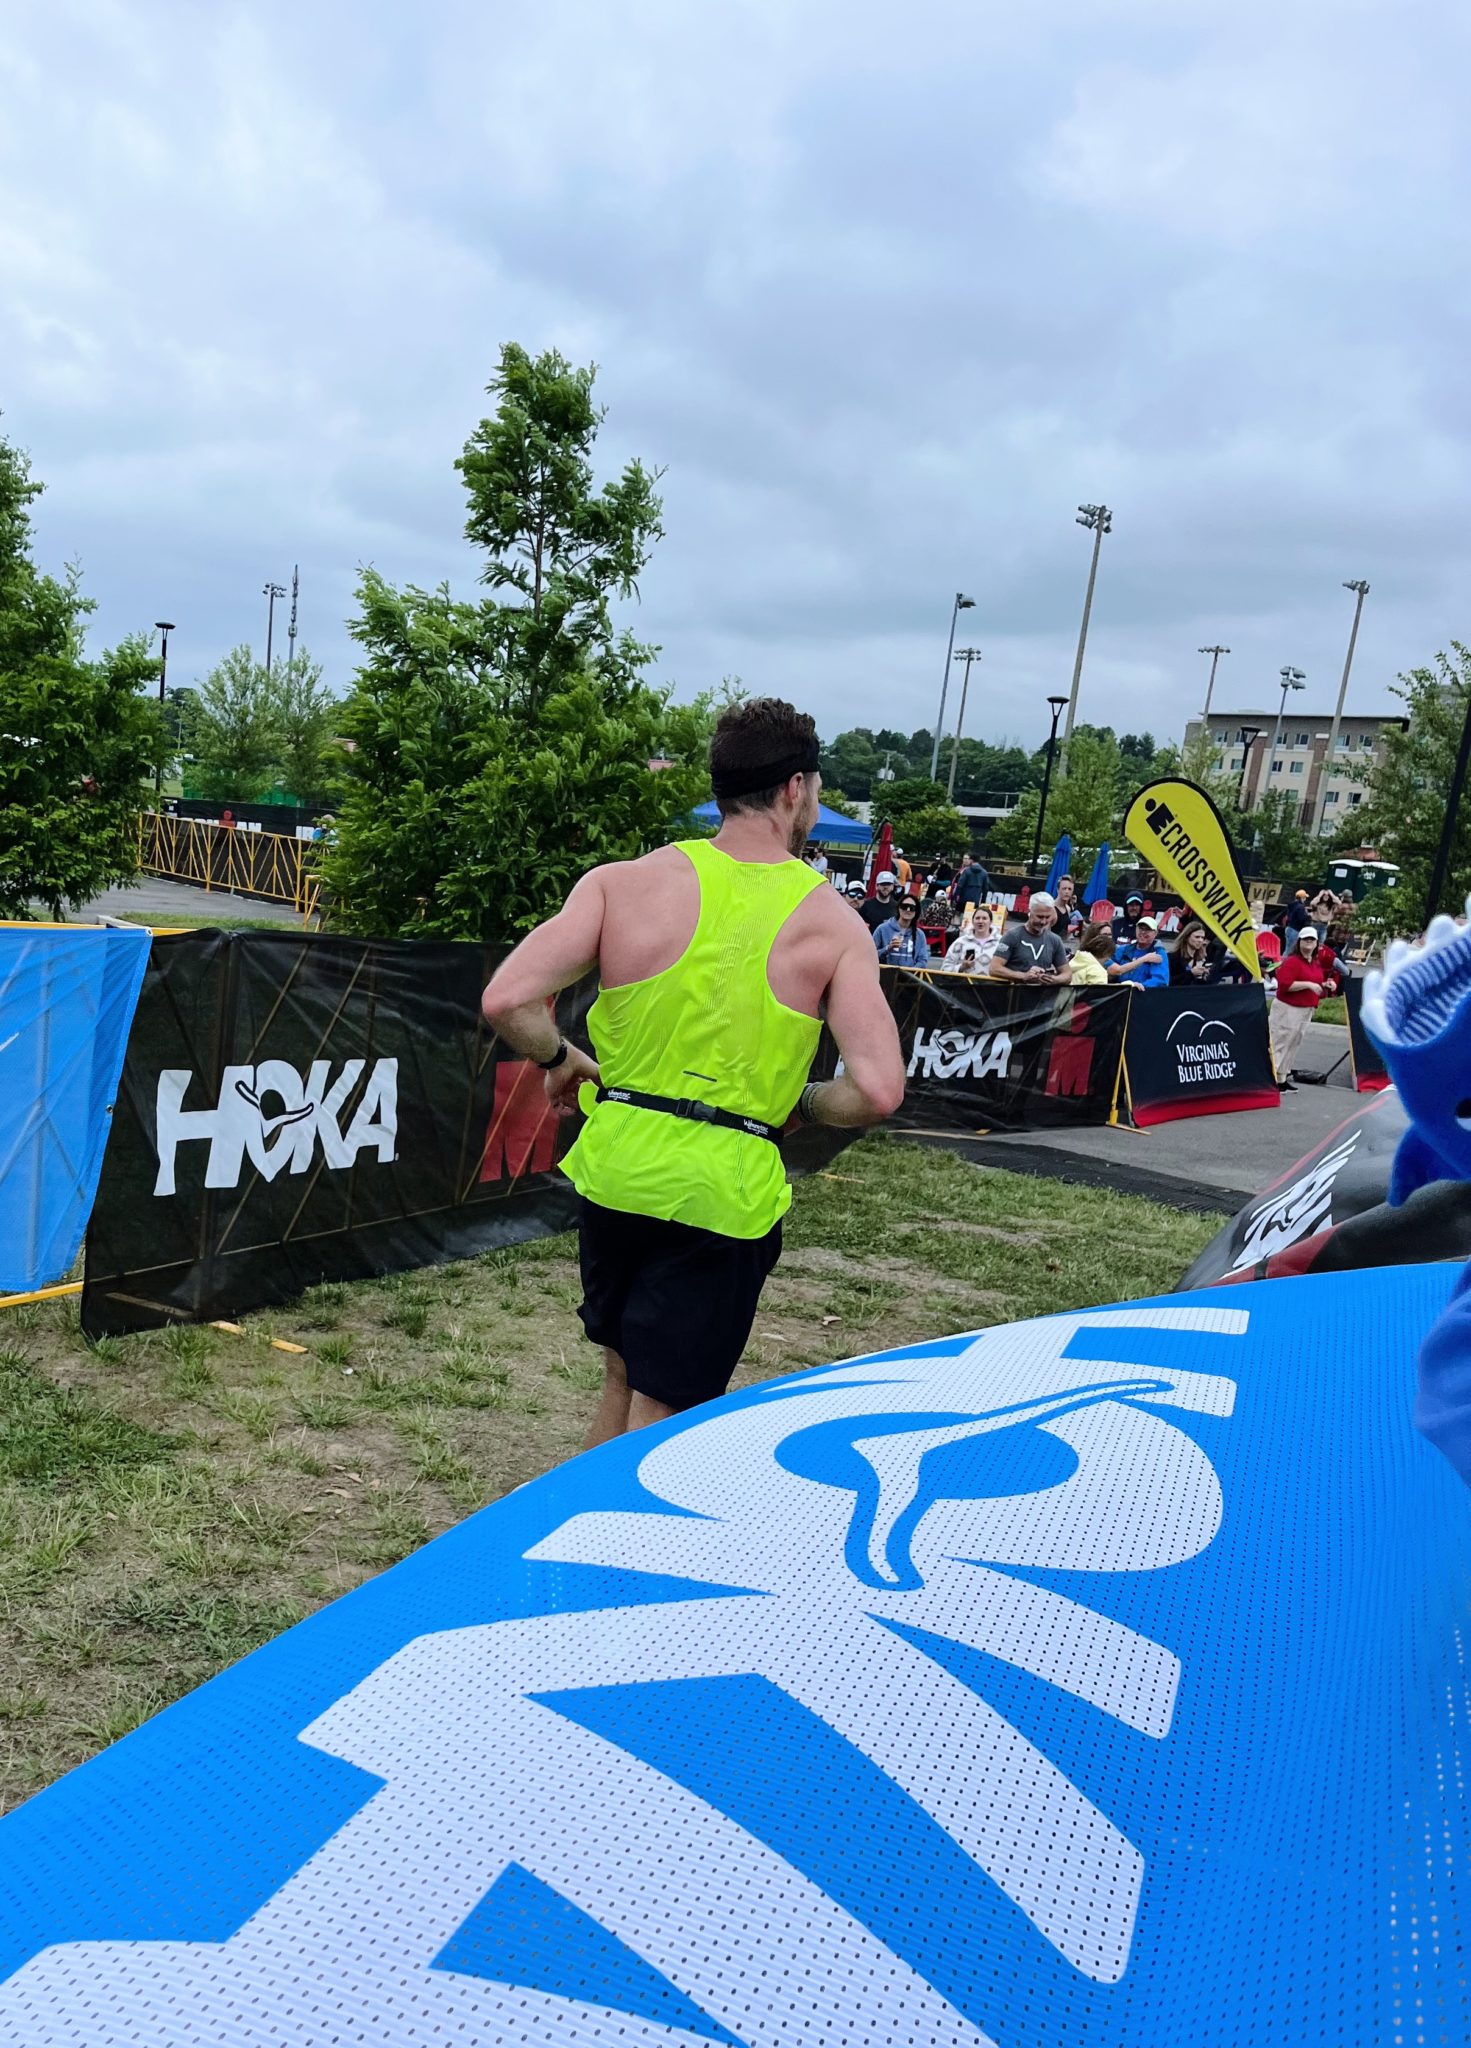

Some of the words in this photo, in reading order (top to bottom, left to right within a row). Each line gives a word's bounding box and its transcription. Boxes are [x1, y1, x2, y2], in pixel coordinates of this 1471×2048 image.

[1160, 823, 1252, 945] CROSSWALK
[1253, 887, 1276, 901] VIP
[906, 1026, 1013, 1079] HOKA
[1176, 1041, 1230, 1063] VIRGINIA'S
[1177, 1064, 1203, 1084] BLUE
[153, 1057, 399, 1196] HOKA
